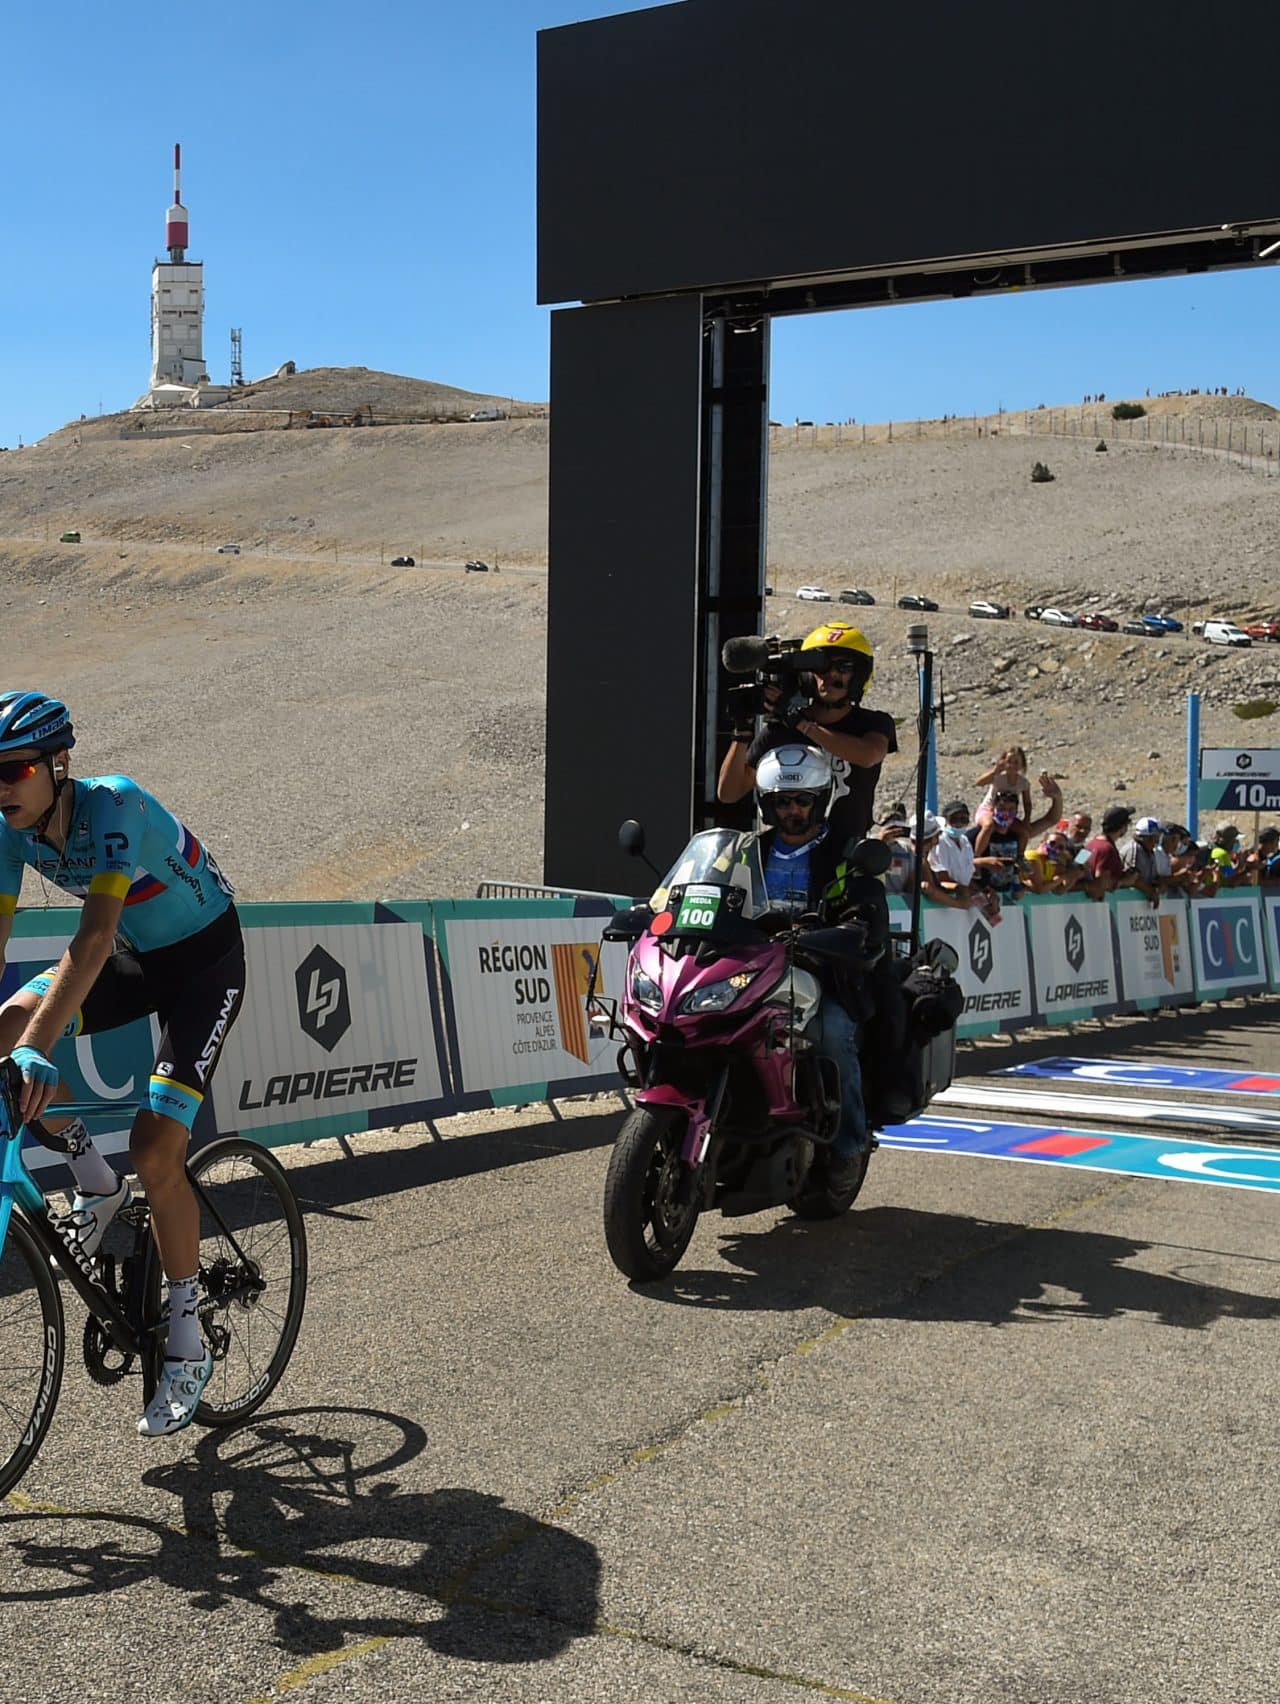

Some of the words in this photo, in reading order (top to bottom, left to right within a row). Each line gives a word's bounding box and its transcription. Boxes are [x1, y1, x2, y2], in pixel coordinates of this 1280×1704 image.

[680, 908, 715, 926] 100
[1206, 918, 1252, 967] CIC
[514, 977, 551, 1005] SUD
[963, 990, 1021, 1014] PIERRE
[1046, 979, 1109, 1002] LAPIERRE
[516, 1011, 553, 1025] PROVENCE
[535, 1025, 556, 1038] ALPES
[194, 988, 239, 1083] ASTANA
[239, 1058, 418, 1111] LAPIERRE
[22, 1325, 56, 1446] CORIMA
[210, 1373, 271, 1412] CORIMA
